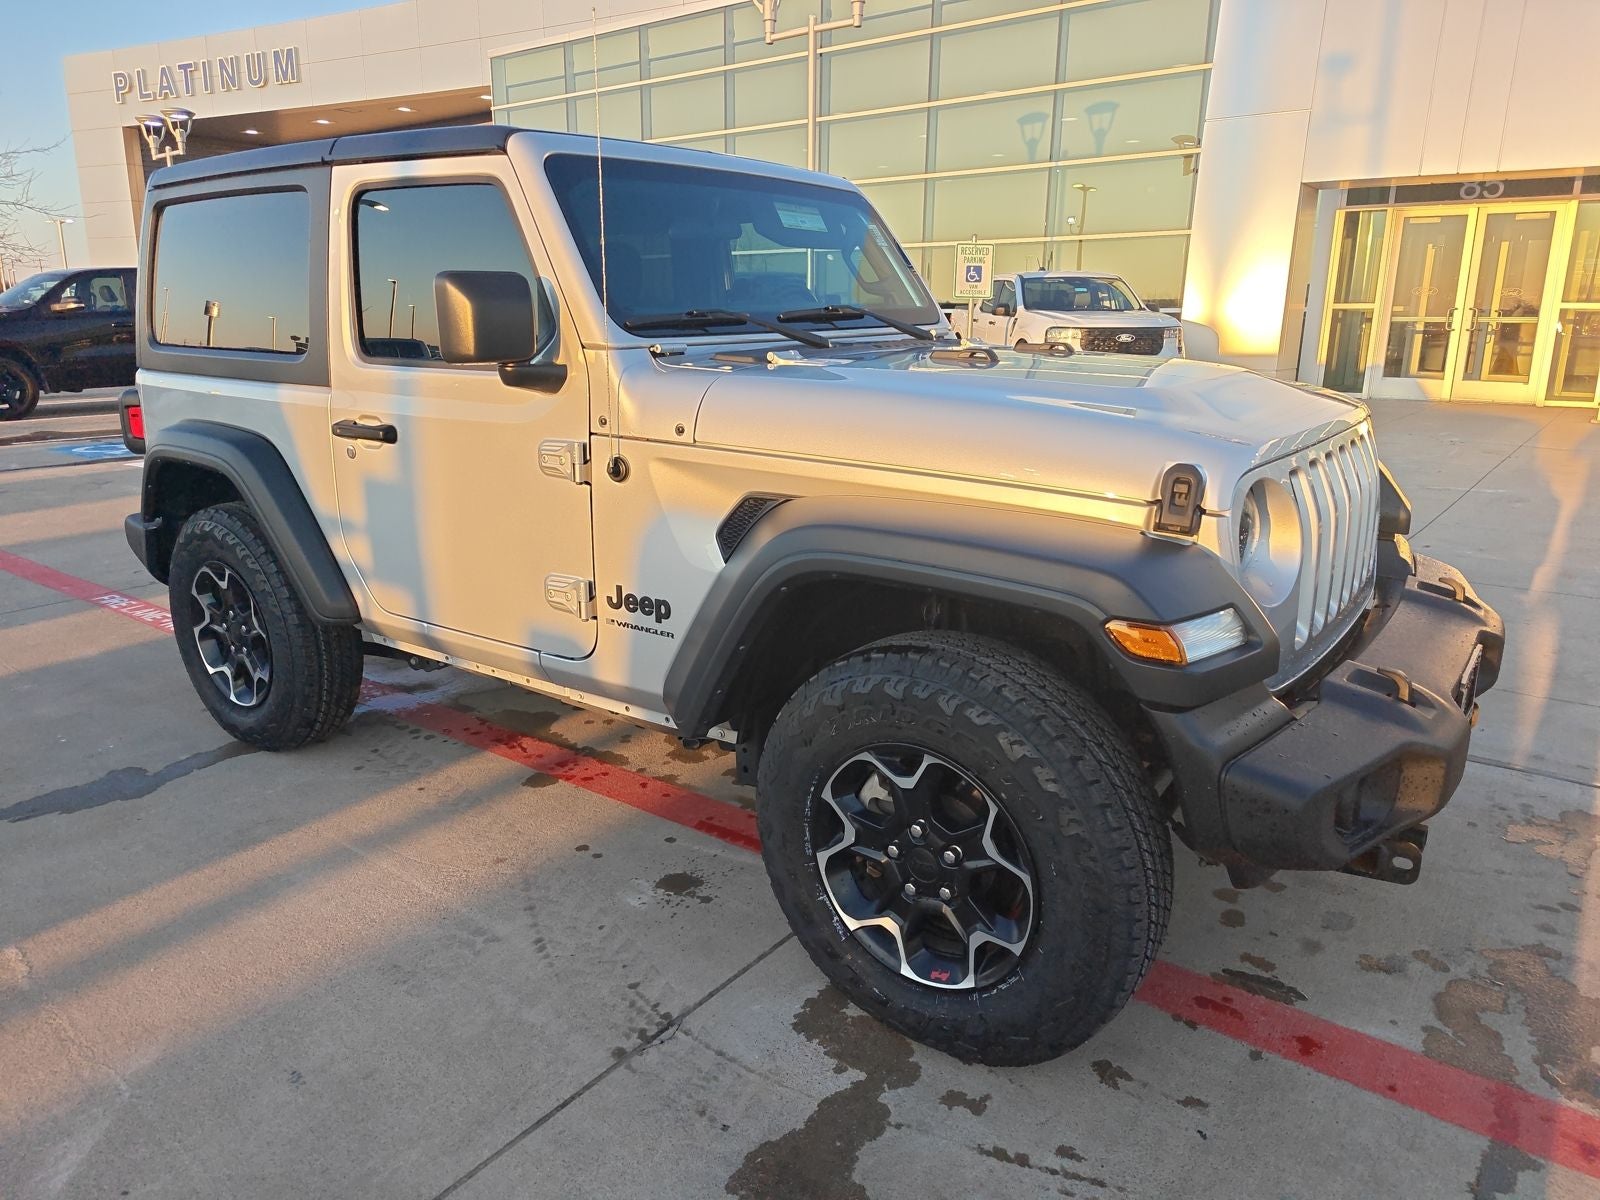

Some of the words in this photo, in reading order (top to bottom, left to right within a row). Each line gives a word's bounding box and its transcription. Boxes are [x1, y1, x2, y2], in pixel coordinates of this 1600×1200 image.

[112, 46, 300, 104] PLATINUM
[960, 246, 990, 256] RESERVED
[963, 256, 986, 264] PARKING
[606, 584, 672, 624] Jeep
[615, 619, 675, 639] WRANGLER
